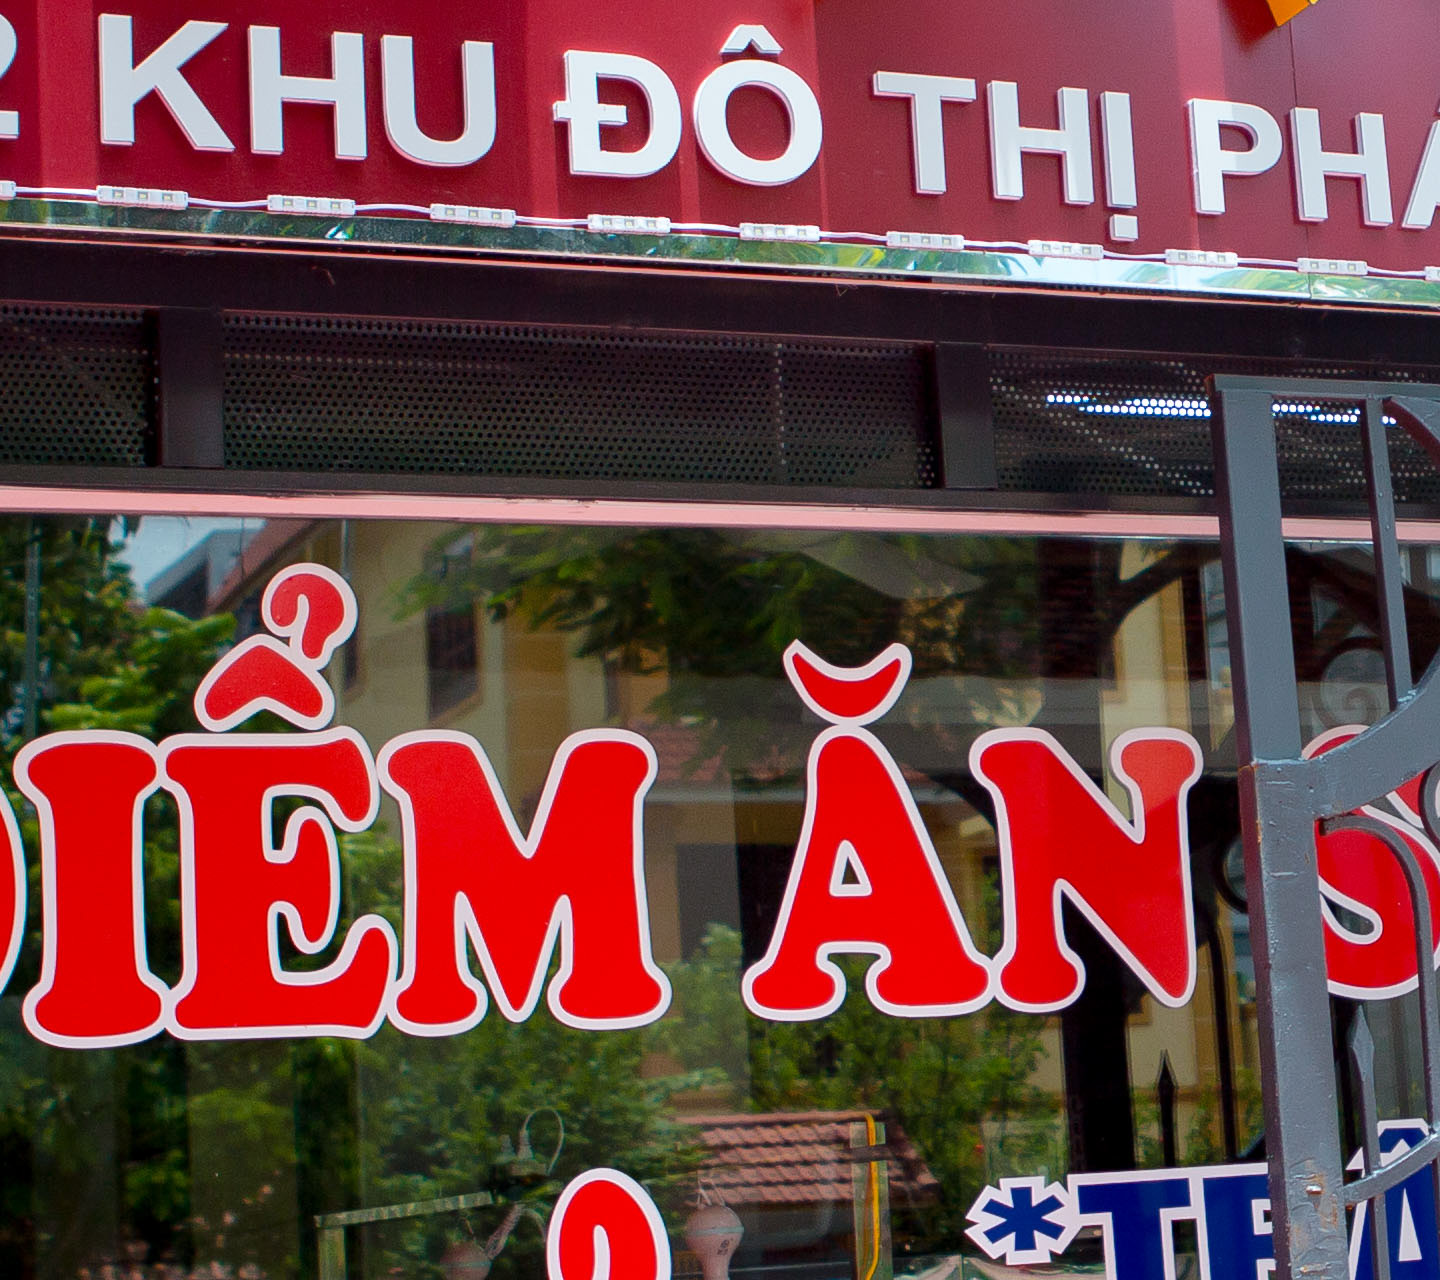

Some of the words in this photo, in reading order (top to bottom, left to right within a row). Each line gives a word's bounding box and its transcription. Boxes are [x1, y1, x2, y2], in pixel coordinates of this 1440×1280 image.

[97, 12, 497, 167] KHU
[552, 23, 823, 188] ĐÔ
[872, 71, 1140, 241] THỊ
[742, 638, 1204, 1021] ĂN
